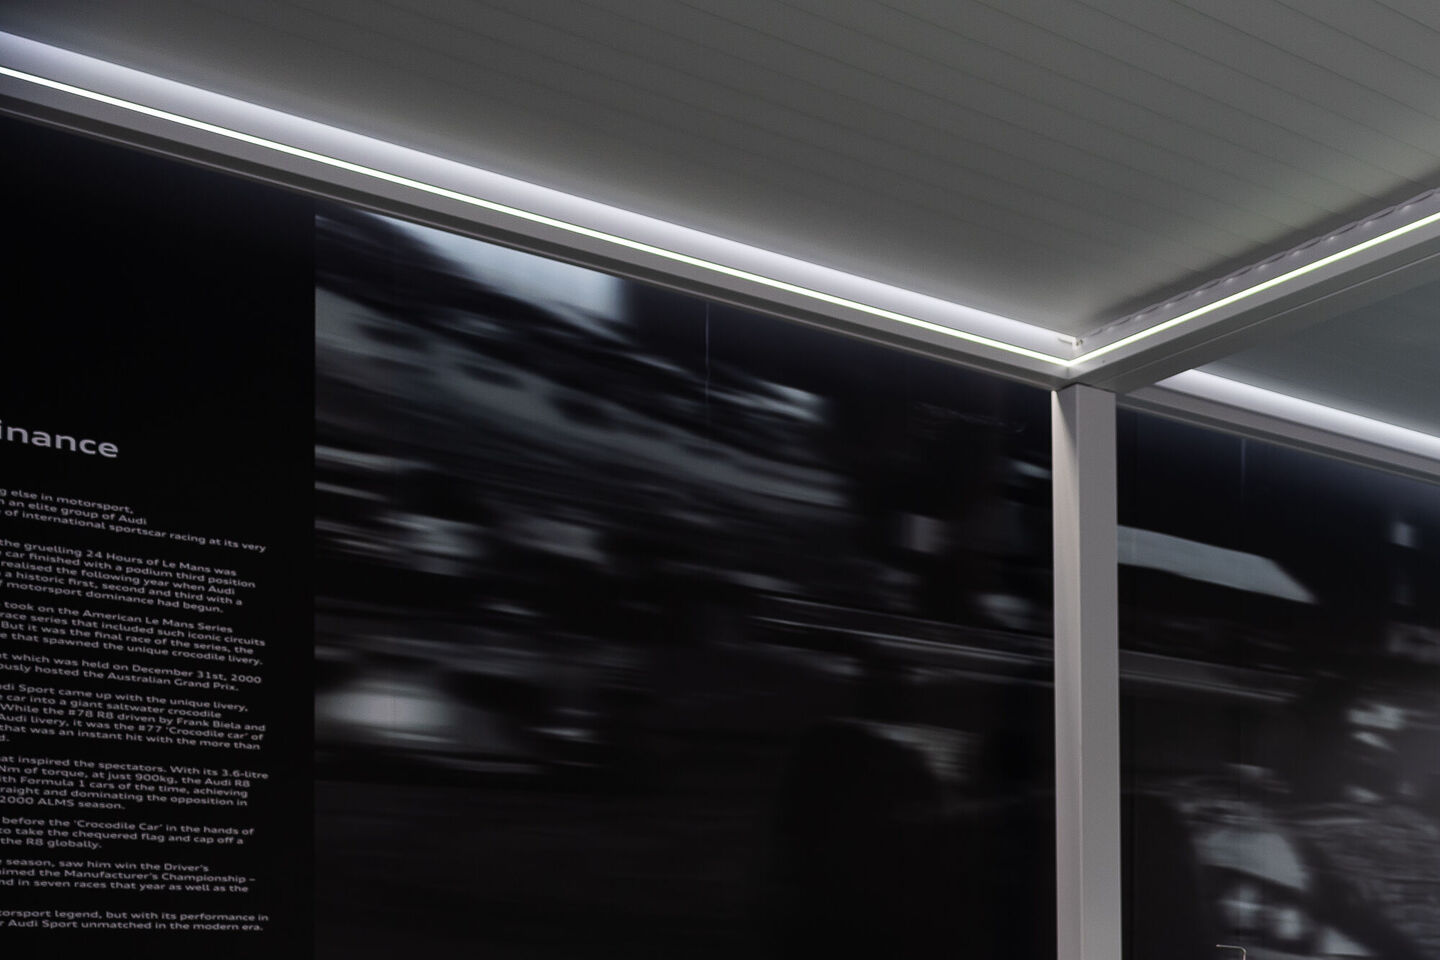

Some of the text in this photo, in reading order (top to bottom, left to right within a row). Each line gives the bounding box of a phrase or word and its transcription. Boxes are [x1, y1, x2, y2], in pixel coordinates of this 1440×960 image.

[11, 489, 38, 499] else
[28, 502, 148, 525] elite group Audi
[22, 511, 266, 552] international sportscar racing its very
[24, 543, 211, 572] gruelling 24 Hours Le Mans
[1, 560, 235, 594] realised following year when Audi
[29, 552, 80, 565] finished
[84, 561, 112, 569] with
[126, 566, 173, 577] podium
[176, 571, 205, 581] third
[208, 576, 256, 587] position
[6, 582, 82, 596] motorsport
[85, 590, 154, 604] dominance
[157, 598, 180, 607] had
[16, 571, 64, 584] historic
[102, 583, 145, 593] second
[174, 591, 204, 600] third
[4, 601, 233, 632] took American Le Mans Series
[1, 620, 24, 630] But
[94, 630, 123, 640] final
[126, 635, 152, 643] race
[30, 615, 266, 646] series that included such iconic circuits
[11, 632, 39, 641] that
[42, 636, 99, 648] spawned
[127, 645, 169, 655] unique
[172, 650, 226, 661] crocodile
[12, 653, 50, 663] which
[82, 659, 109, 669] held
[132, 664, 193, 676] December
[231, 673, 262, 683] 2000
[35, 665, 80, 676] hosted
[107, 672, 171, 684] Australian
[174, 678, 210, 688] Grand
[18, 684, 55, 694] Sport
[58, 689, 93, 697] came
[115, 693, 143, 701] with
[170, 698, 211, 707] unique
[30, 696, 56, 704] into
[70, 700, 103, 708] giant
[106, 703, 165, 713] saltwater
[168, 708, 222, 718] crocodile
[0, 703, 39, 713] While
[97, 710, 114, 719] R8
[117, 713, 156, 722] driven
[176, 717, 209, 726] Frank
[78, 730, 122, 740] instant
[126, 733, 143, 741] hit
[146, 735, 173, 743] with
[234, 741, 260, 749] than
[18, 756, 70, 766] inspired
[170, 765, 200, 774] With
[20, 775, 74, 786] Formula
[193, 787, 248, 798] achieving
[107, 771, 132, 780] just
[204, 777, 232, 786] Audi
[234, 779, 251, 787] R8
[0, 795, 34, 804] 2000
[38, 797, 75, 806] ALMS
[70, 789, 234, 805] dominating opposition
[2, 816, 45, 825] before
[203, 825, 239, 834] hands
[15, 827, 44, 835] take
[72, 830, 138, 839] chequered
[141, 832, 165, 842] flag
[26, 837, 44, 846] R8
[87, 860, 112, 868] him
[110, 881, 136, 889] that
[161, 872, 247, 883] Championship
[8, 919, 38, 927] Audi
[42, 919, 78, 928] Sport
[106, 911, 128, 919] but
[180, 912, 256, 921] performance
